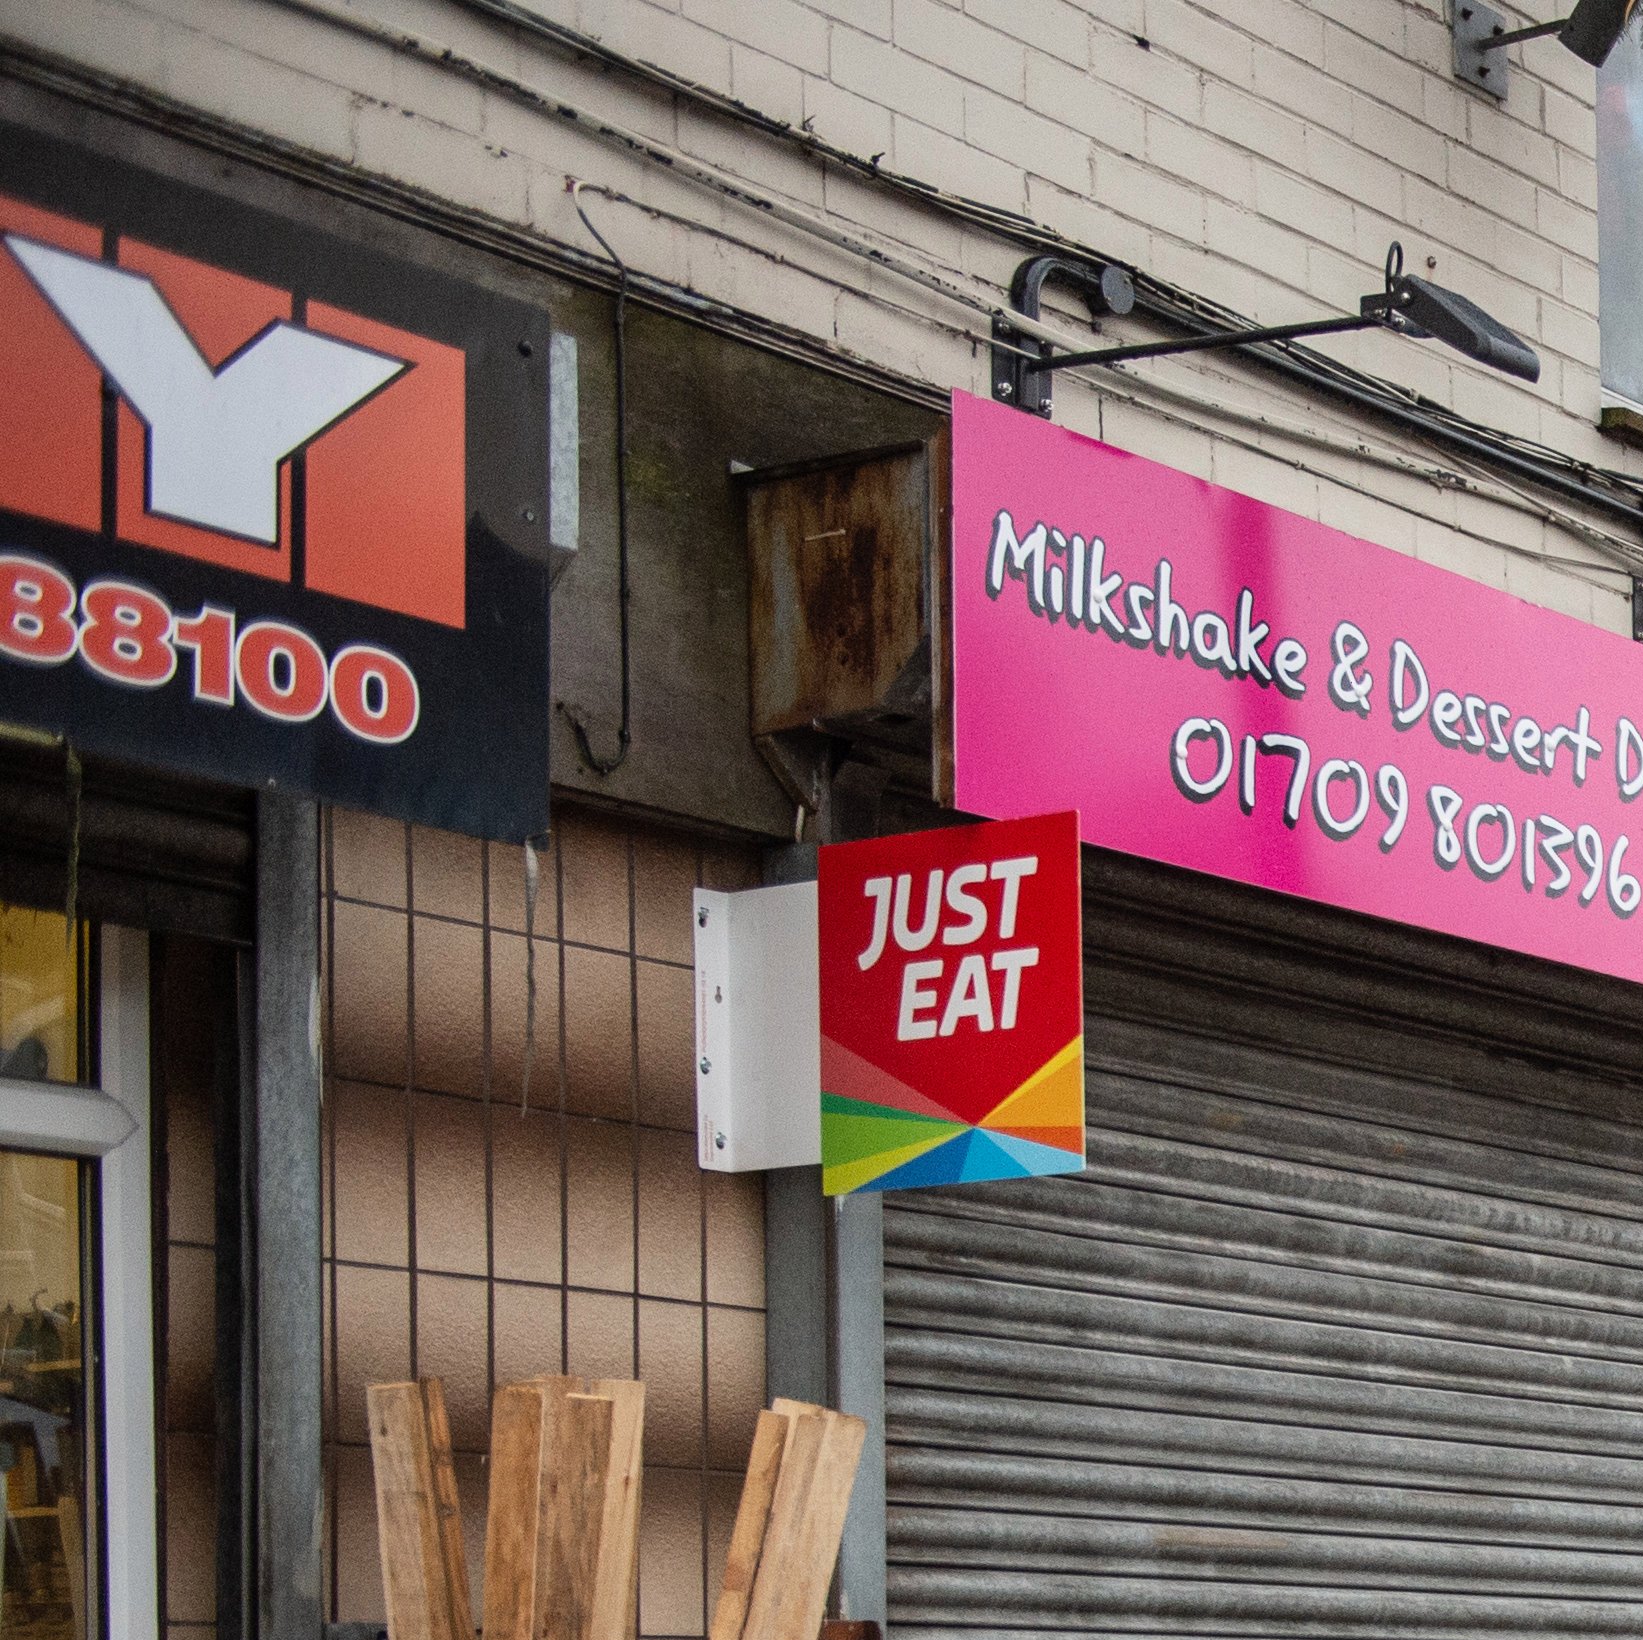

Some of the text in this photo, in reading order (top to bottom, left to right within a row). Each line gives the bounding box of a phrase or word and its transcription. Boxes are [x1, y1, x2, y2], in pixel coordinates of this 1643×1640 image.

[986, 510, 1308, 694] Milkshake
[1329, 621, 1371, 713] &
[1391, 639, 1602, 784] Dessert
[1171, 718, 1643, 919] 01709 801396
[857, 856, 1038, 971] JUST
[897, 947, 1039, 1041] EAT
